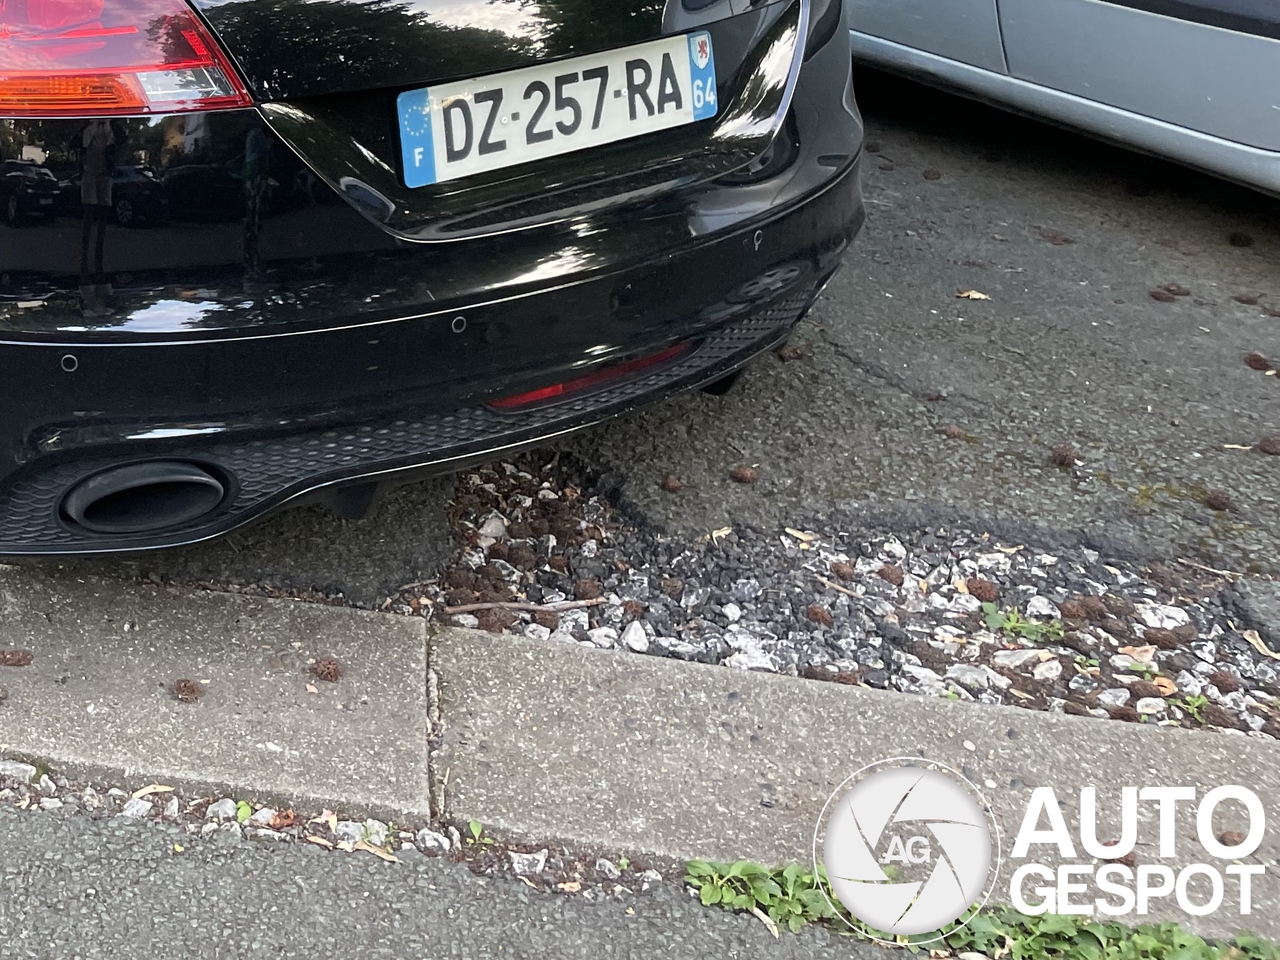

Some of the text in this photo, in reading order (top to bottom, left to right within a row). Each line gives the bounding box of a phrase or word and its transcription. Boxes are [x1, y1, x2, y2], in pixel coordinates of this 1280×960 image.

[442, 52, 683, 164] DZ-257-RA
[692, 77, 716, 109] 64
[414, 147, 424, 168] F
